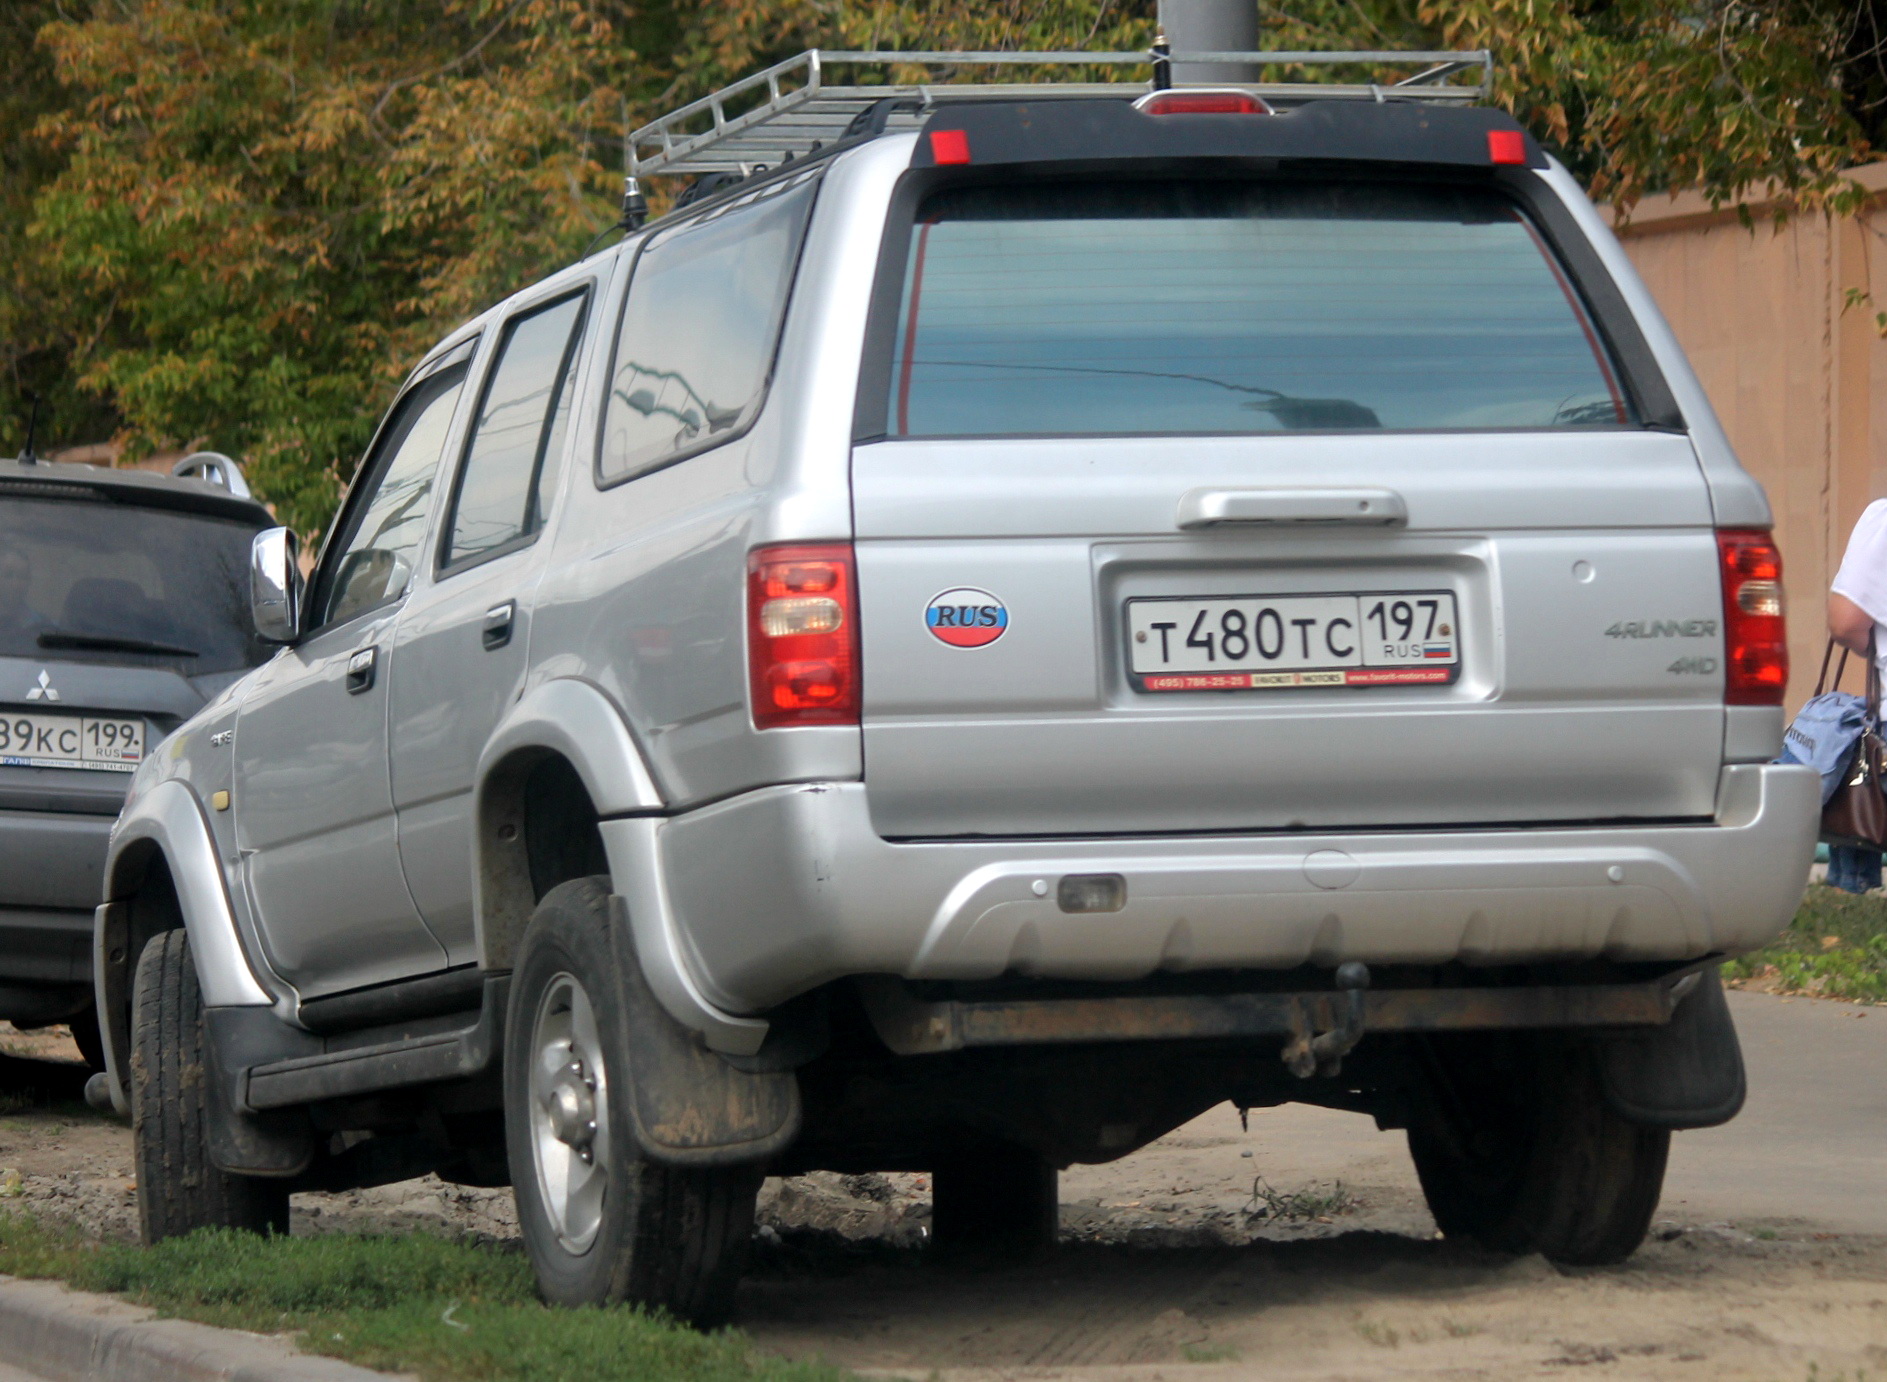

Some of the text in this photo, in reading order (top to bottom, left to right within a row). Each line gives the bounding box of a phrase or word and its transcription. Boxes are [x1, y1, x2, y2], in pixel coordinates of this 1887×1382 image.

[935, 604, 999, 628] RUS
[1150, 600, 1439, 664] T480TC 197
[1603, 620, 1718, 639] 4RUNNER
[1383, 644, 1423, 659] RUS
[1302, 673, 1341, 683] MOTORS
[87, 721, 135, 748] 199
[95, 747, 120, 758] RUS
